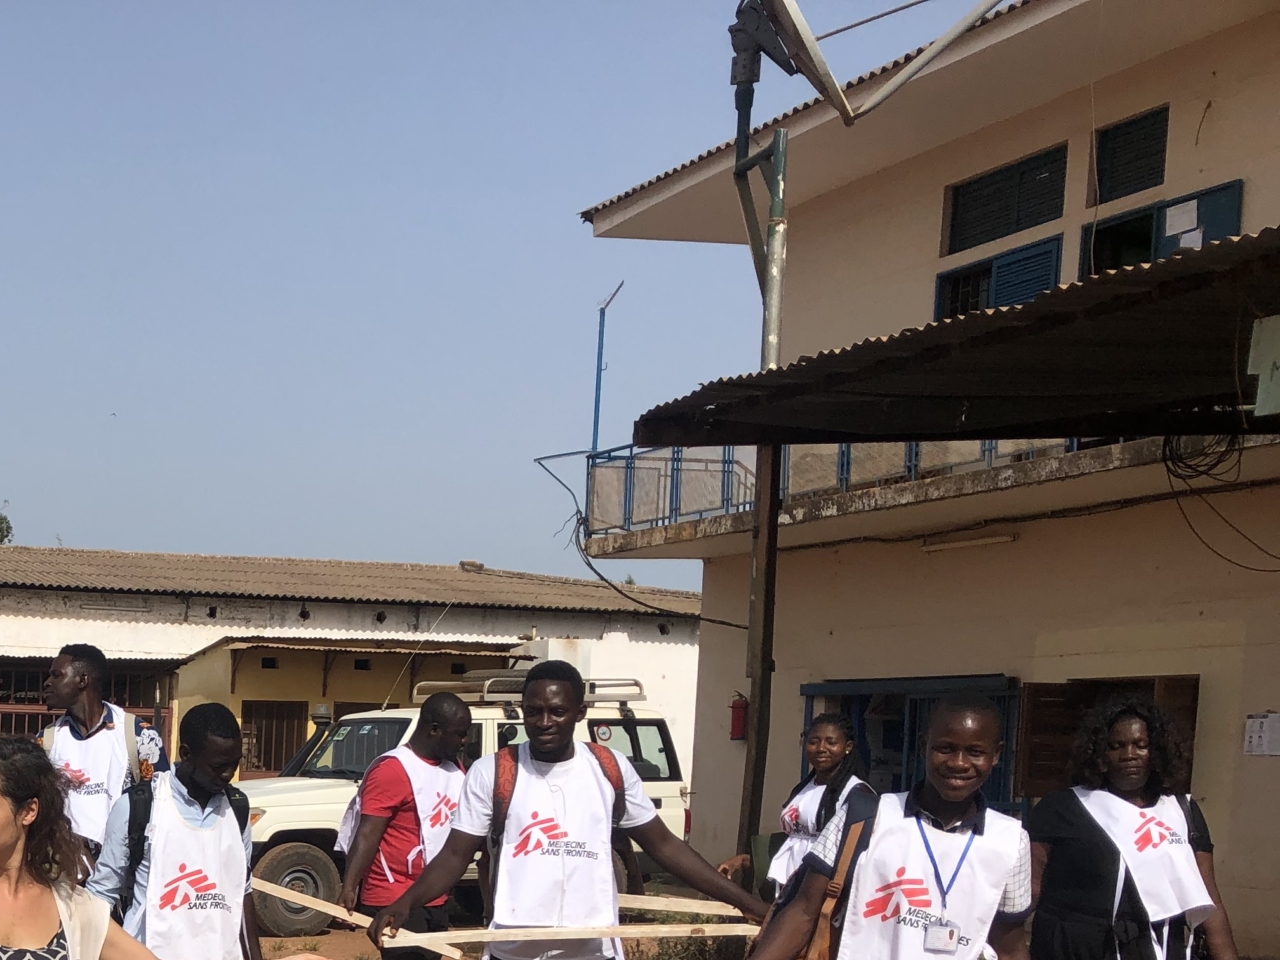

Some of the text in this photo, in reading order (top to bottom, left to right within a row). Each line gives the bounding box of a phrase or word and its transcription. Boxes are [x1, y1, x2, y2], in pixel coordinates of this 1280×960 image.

[547, 840, 587, 849] MEDECINS
[540, 848, 561, 857] SANS
[187, 902, 208, 910] SANS
[896, 915, 921, 929] SANS
